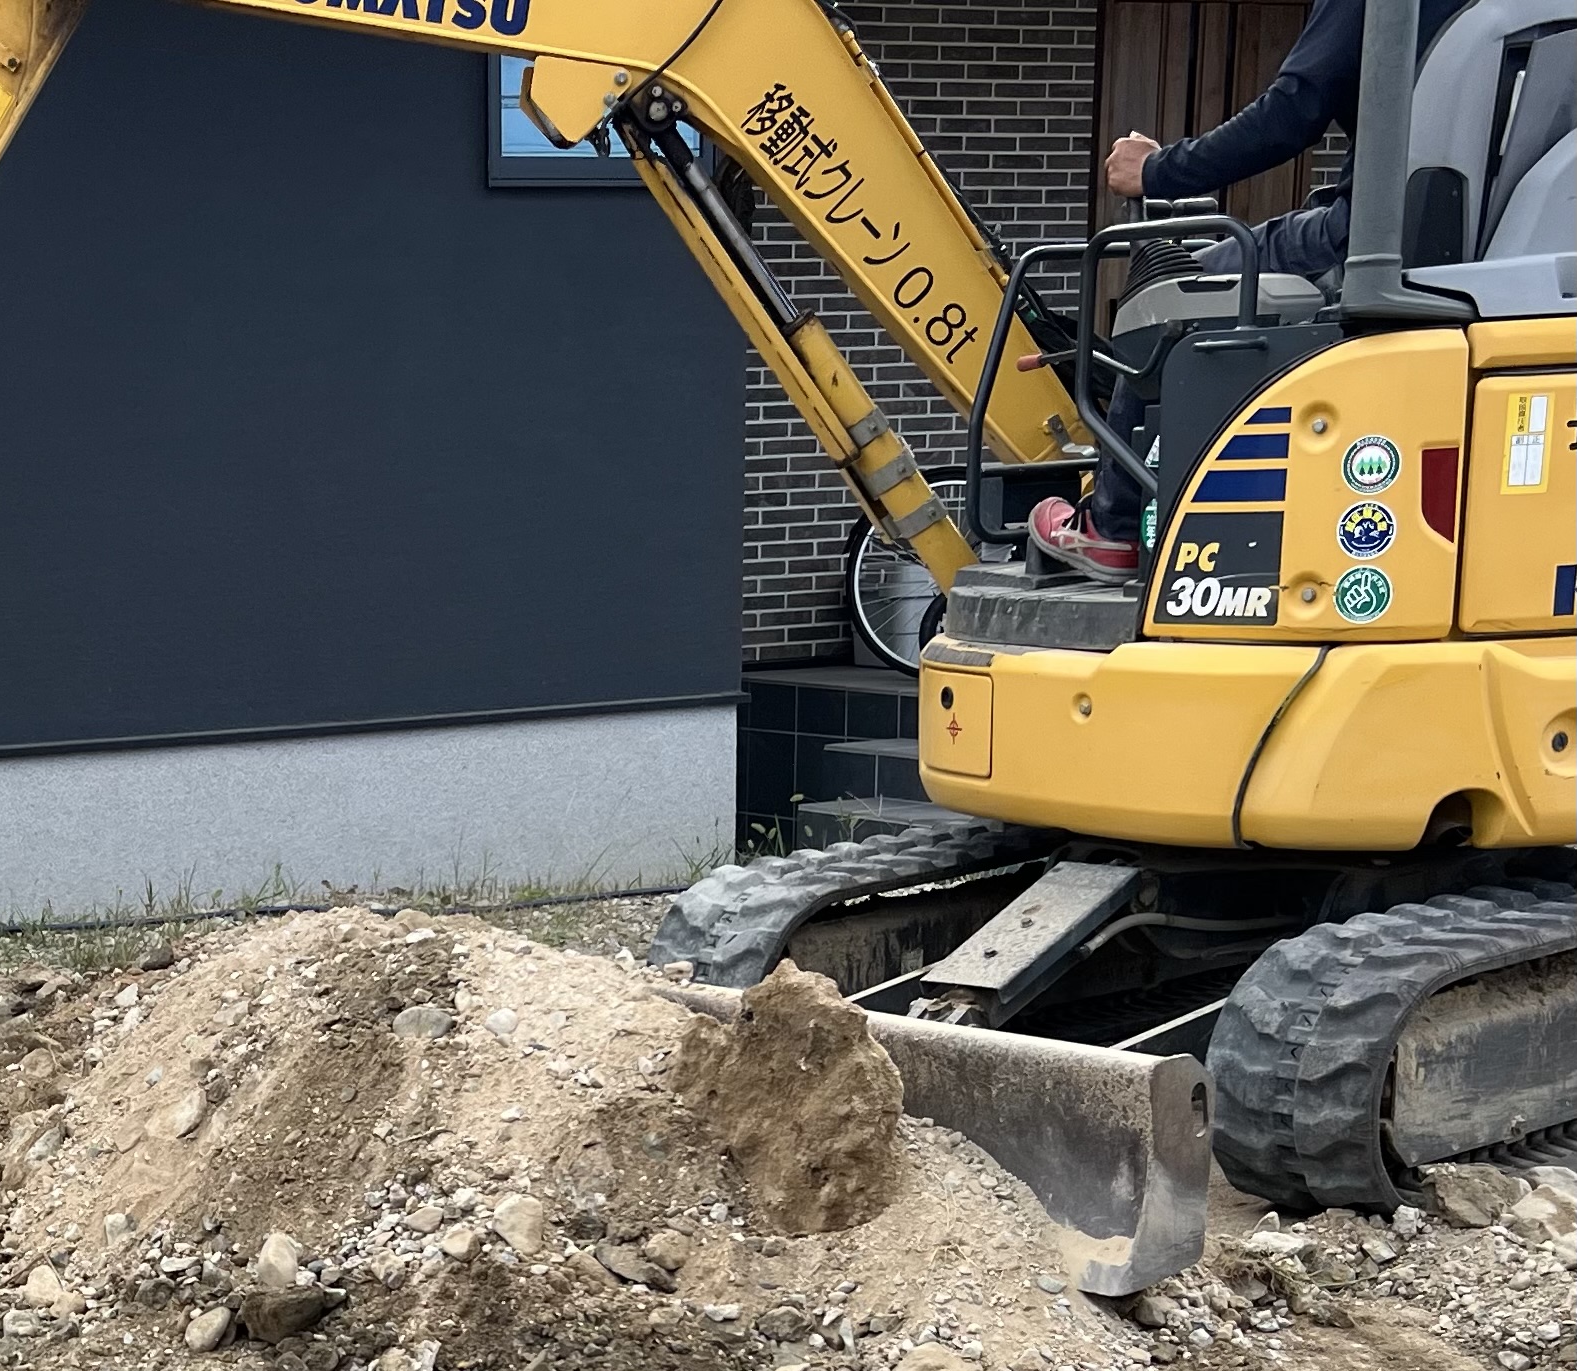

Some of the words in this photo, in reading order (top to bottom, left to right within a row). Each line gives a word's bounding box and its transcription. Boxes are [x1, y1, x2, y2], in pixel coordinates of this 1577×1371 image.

[741, 83, 910, 265] 移動式クレーン
[894, 266, 978, 364] 0.8t
[1175, 542, 1220, 572] PC
[1166, 577, 1272, 616] 30MR
